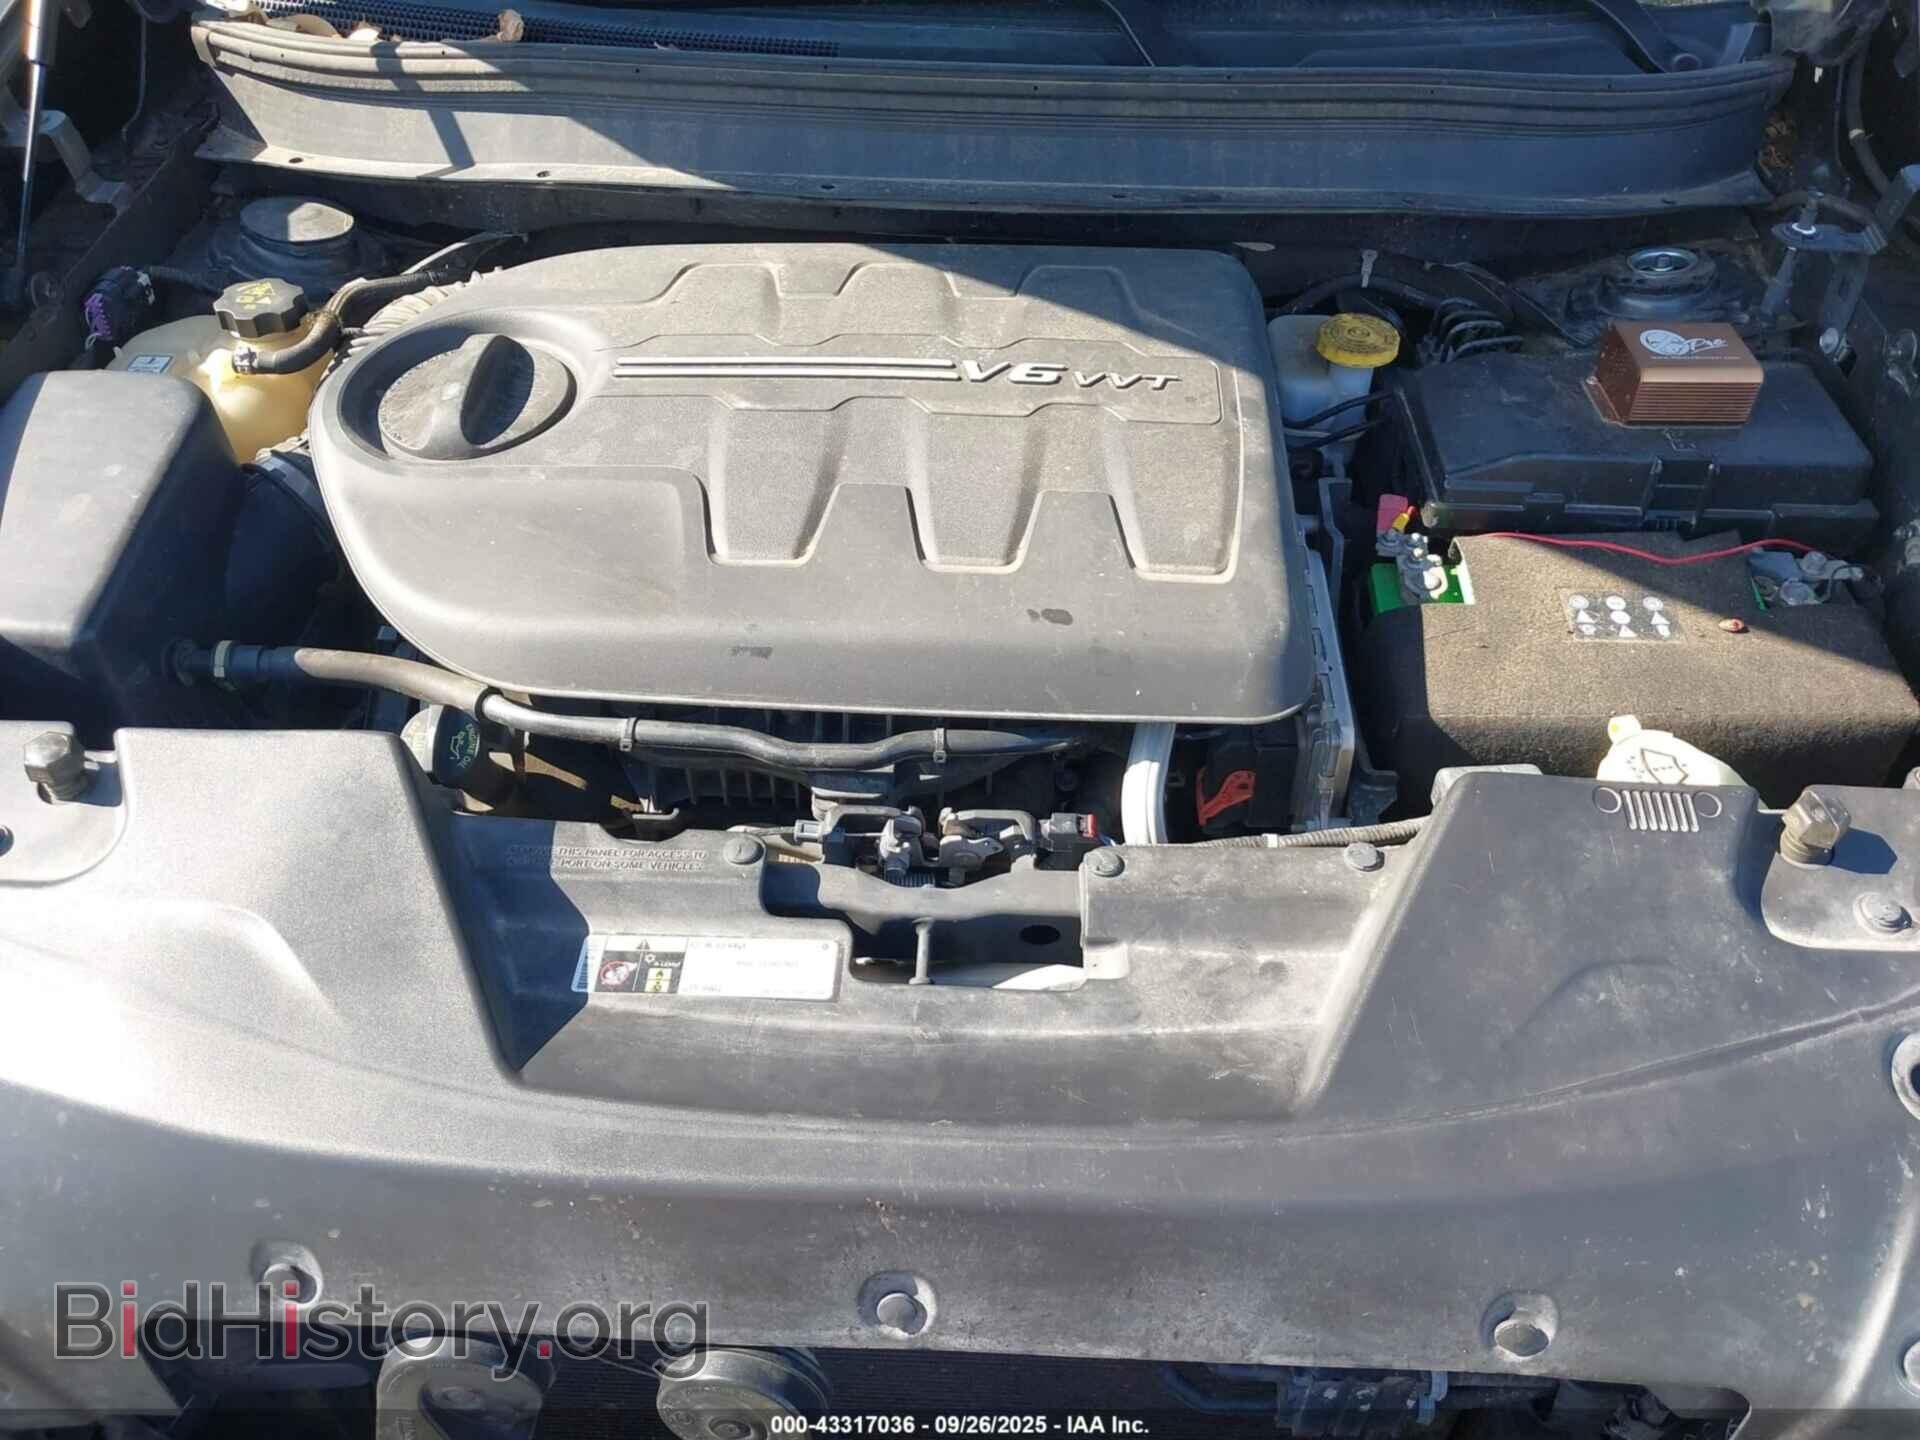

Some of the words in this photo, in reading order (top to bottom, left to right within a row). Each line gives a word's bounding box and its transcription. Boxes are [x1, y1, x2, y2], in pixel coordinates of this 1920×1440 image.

[962, 359, 1069, 386] V6
[1072, 370, 1183, 392] VVT
[558, 846, 582, 858] THIS
[584, 847, 618, 858] PANEL
[620, 847, 645, 858] FOR
[647, 848, 690, 859] ACCESS
[693, 849, 708, 860] TO
[560, 858, 590, 869] PORT
[613, 860, 643, 871] SOME
[649, 860, 705, 872] VEHICLES
